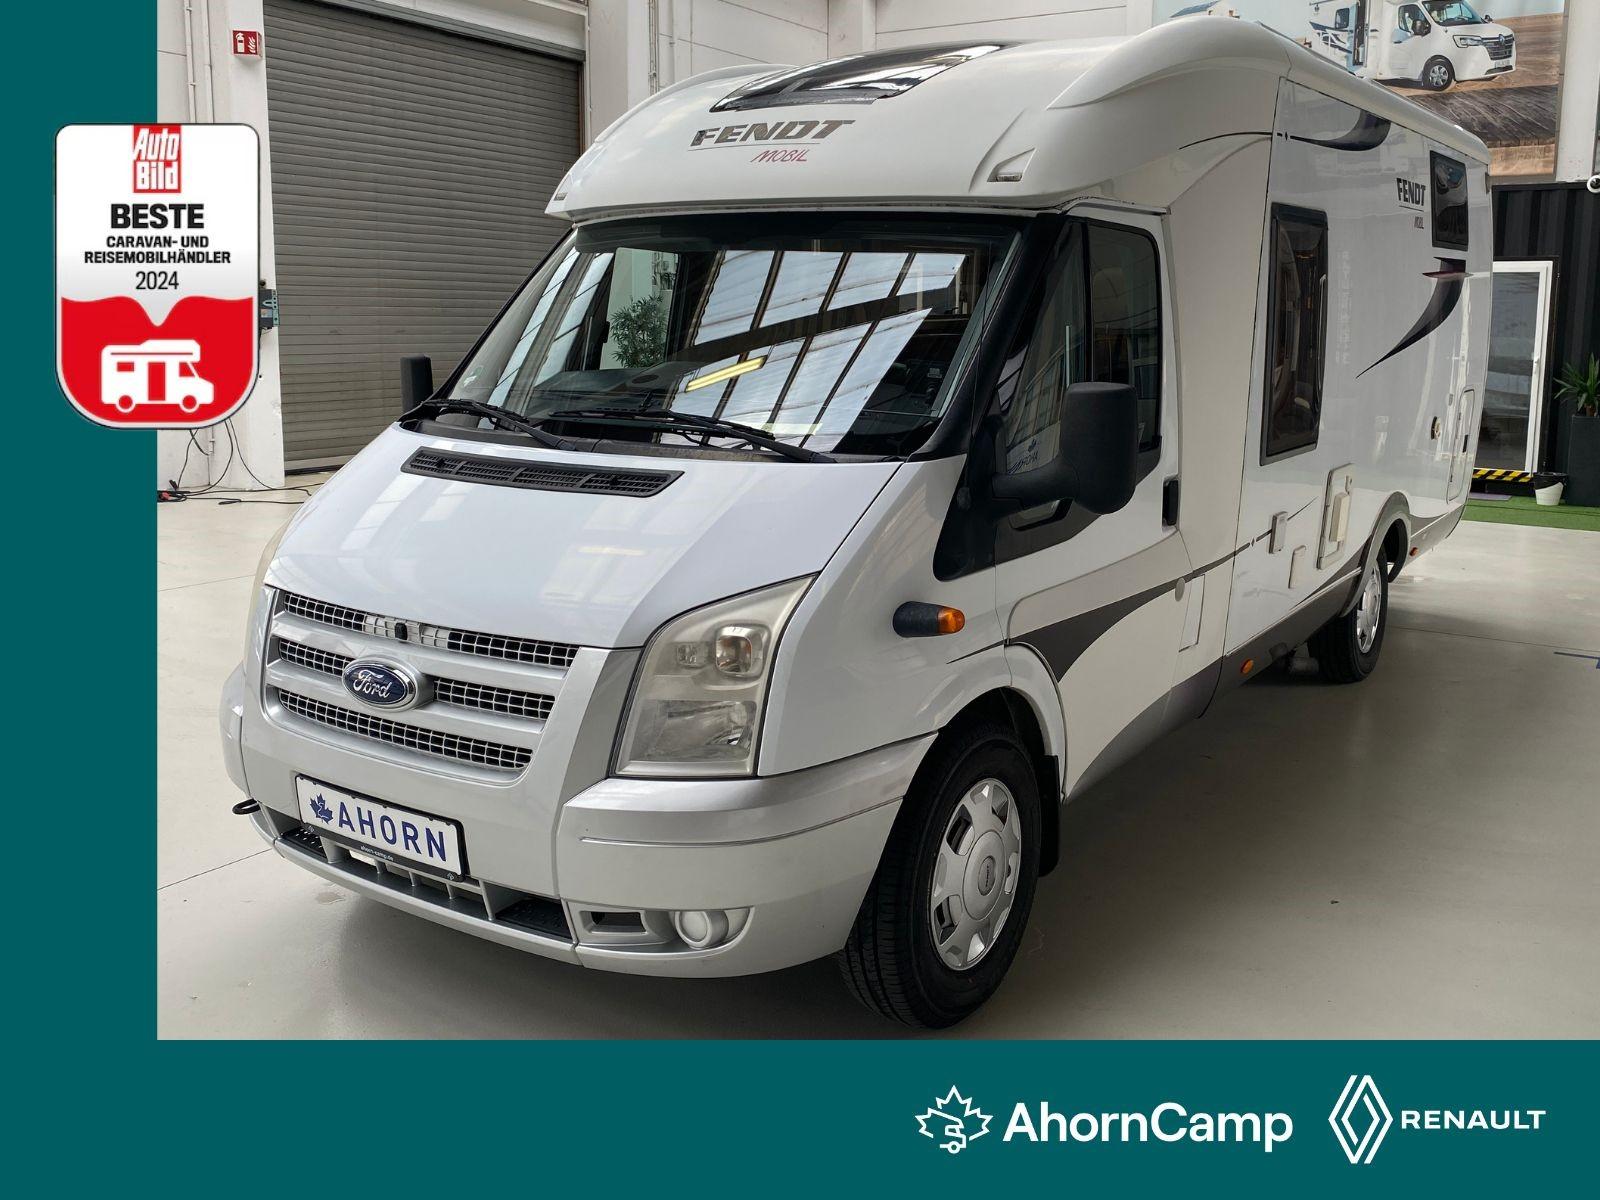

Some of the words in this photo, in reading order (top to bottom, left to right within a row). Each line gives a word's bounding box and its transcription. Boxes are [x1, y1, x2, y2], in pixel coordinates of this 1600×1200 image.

[690, 120, 856, 147] FENDT
[750, 150, 810, 163] MOBIL
[1396, 177, 1426, 206] FENDT
[353, 669, 392, 698] Ford
[338, 801, 447, 862] AHORN
